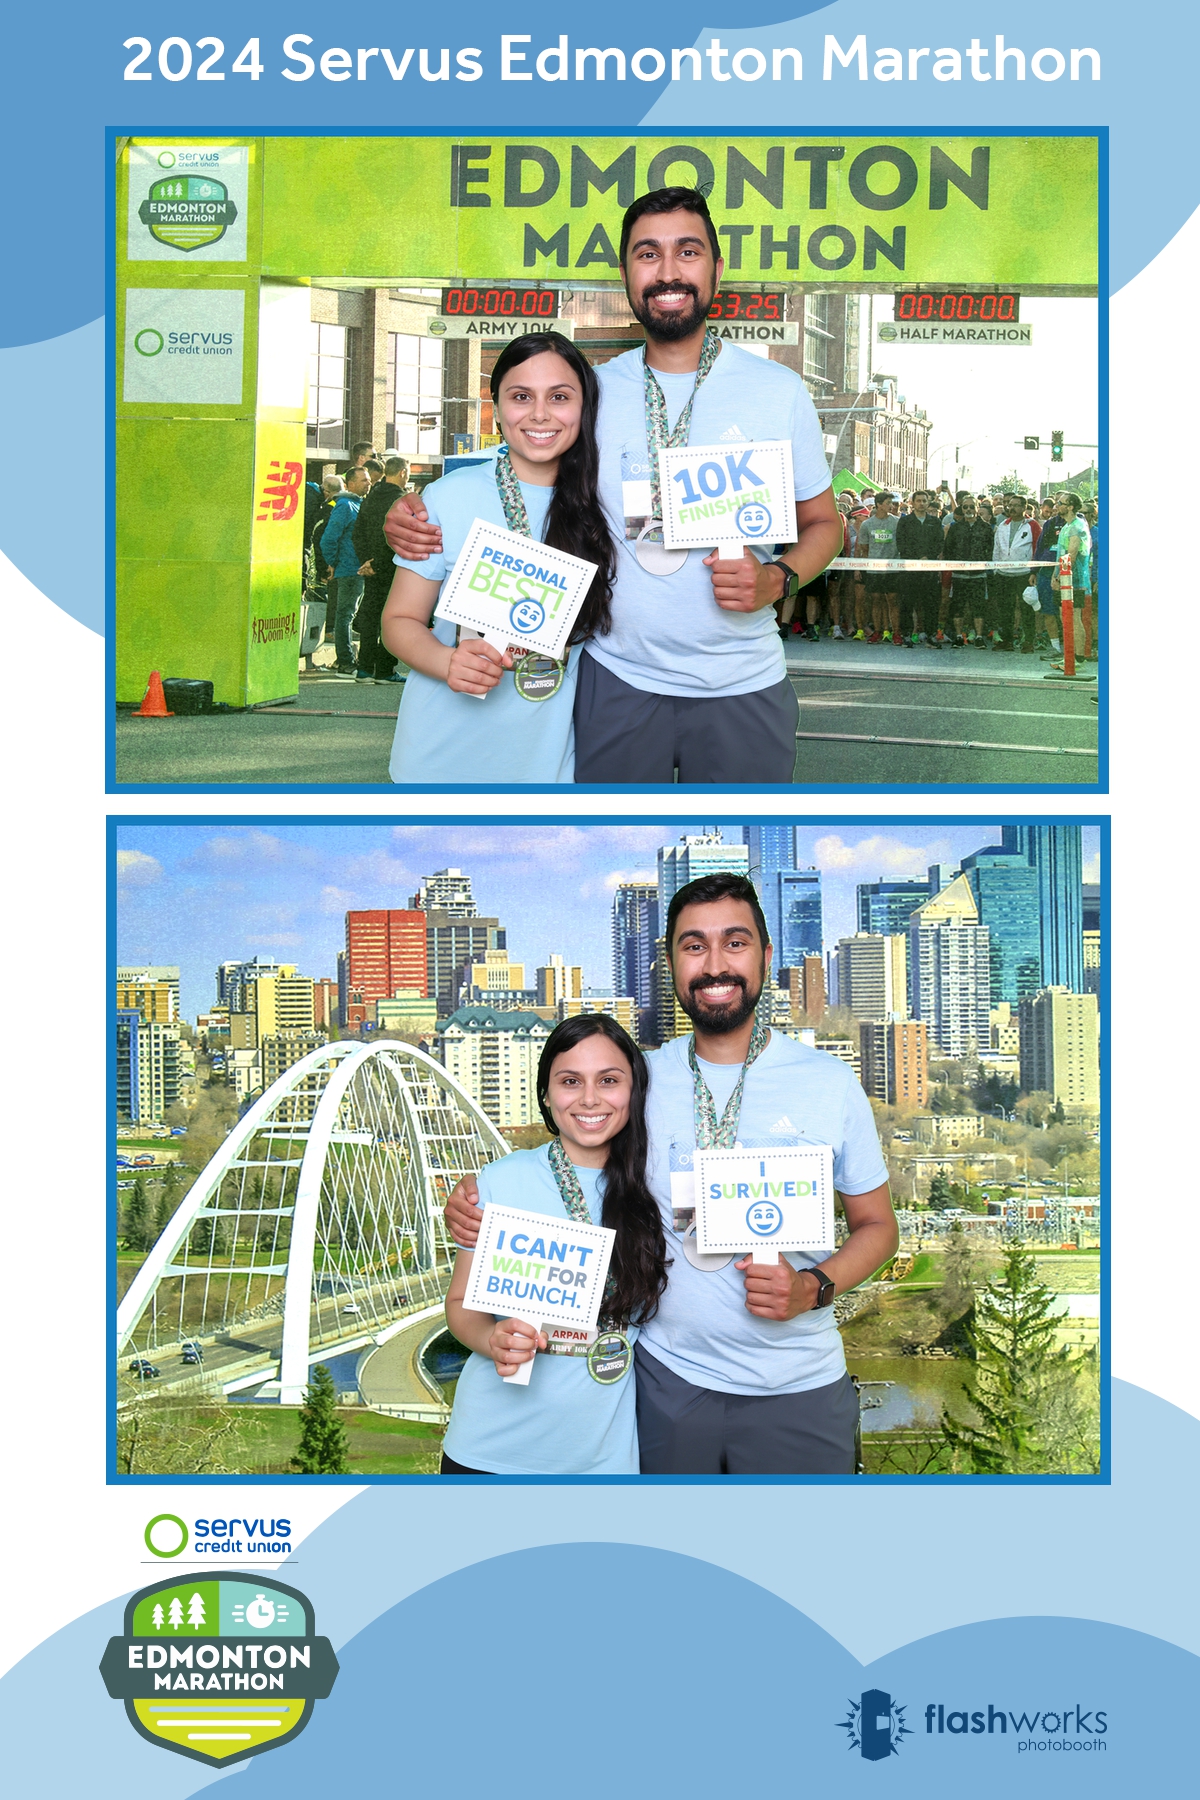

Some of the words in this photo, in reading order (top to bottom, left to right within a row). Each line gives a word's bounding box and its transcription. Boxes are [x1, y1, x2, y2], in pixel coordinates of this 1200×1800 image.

[178, 152, 219, 161] servus
[450, 145, 990, 211] EDMONTON
[149, 203, 227, 214] EDMONTON
[160, 214, 215, 222] MARATHON
[523, 223, 907, 271] MATHON
[466, 321, 517, 335] ARMY
[521, 322, 554, 334] 10K
[707, 325, 785, 340] RATHON
[900, 328, 939, 340] HALF
[943, 328, 1031, 341] MARATHON
[168, 332, 233, 345] servus
[168, 345, 200, 355] credit
[202, 346, 233, 355] union
[673, 449, 766, 505] 10K
[678, 488, 772, 524] FINISHER!
[481, 546, 568, 590] PERSONAL
[467, 560, 565, 620] BEST!
[257, 613, 290, 637] Running
[506, 646, 529, 656] PAN
[759, 1161, 766, 1177] I
[709, 1181, 817, 1200] SURVIVED!
[496, 1230, 505, 1250] I
[510, 1233, 593, 1267] CAN'T
[492, 1254, 546, 1280] WAIT
[547, 1266, 588, 1289] FOR
[486, 1275, 582, 1309] BRUNCH.
[552, 1329, 588, 1341] ARPAN
[550, 1343, 573, 1353] ARMY
[574, 1345, 588, 1354] 10K
